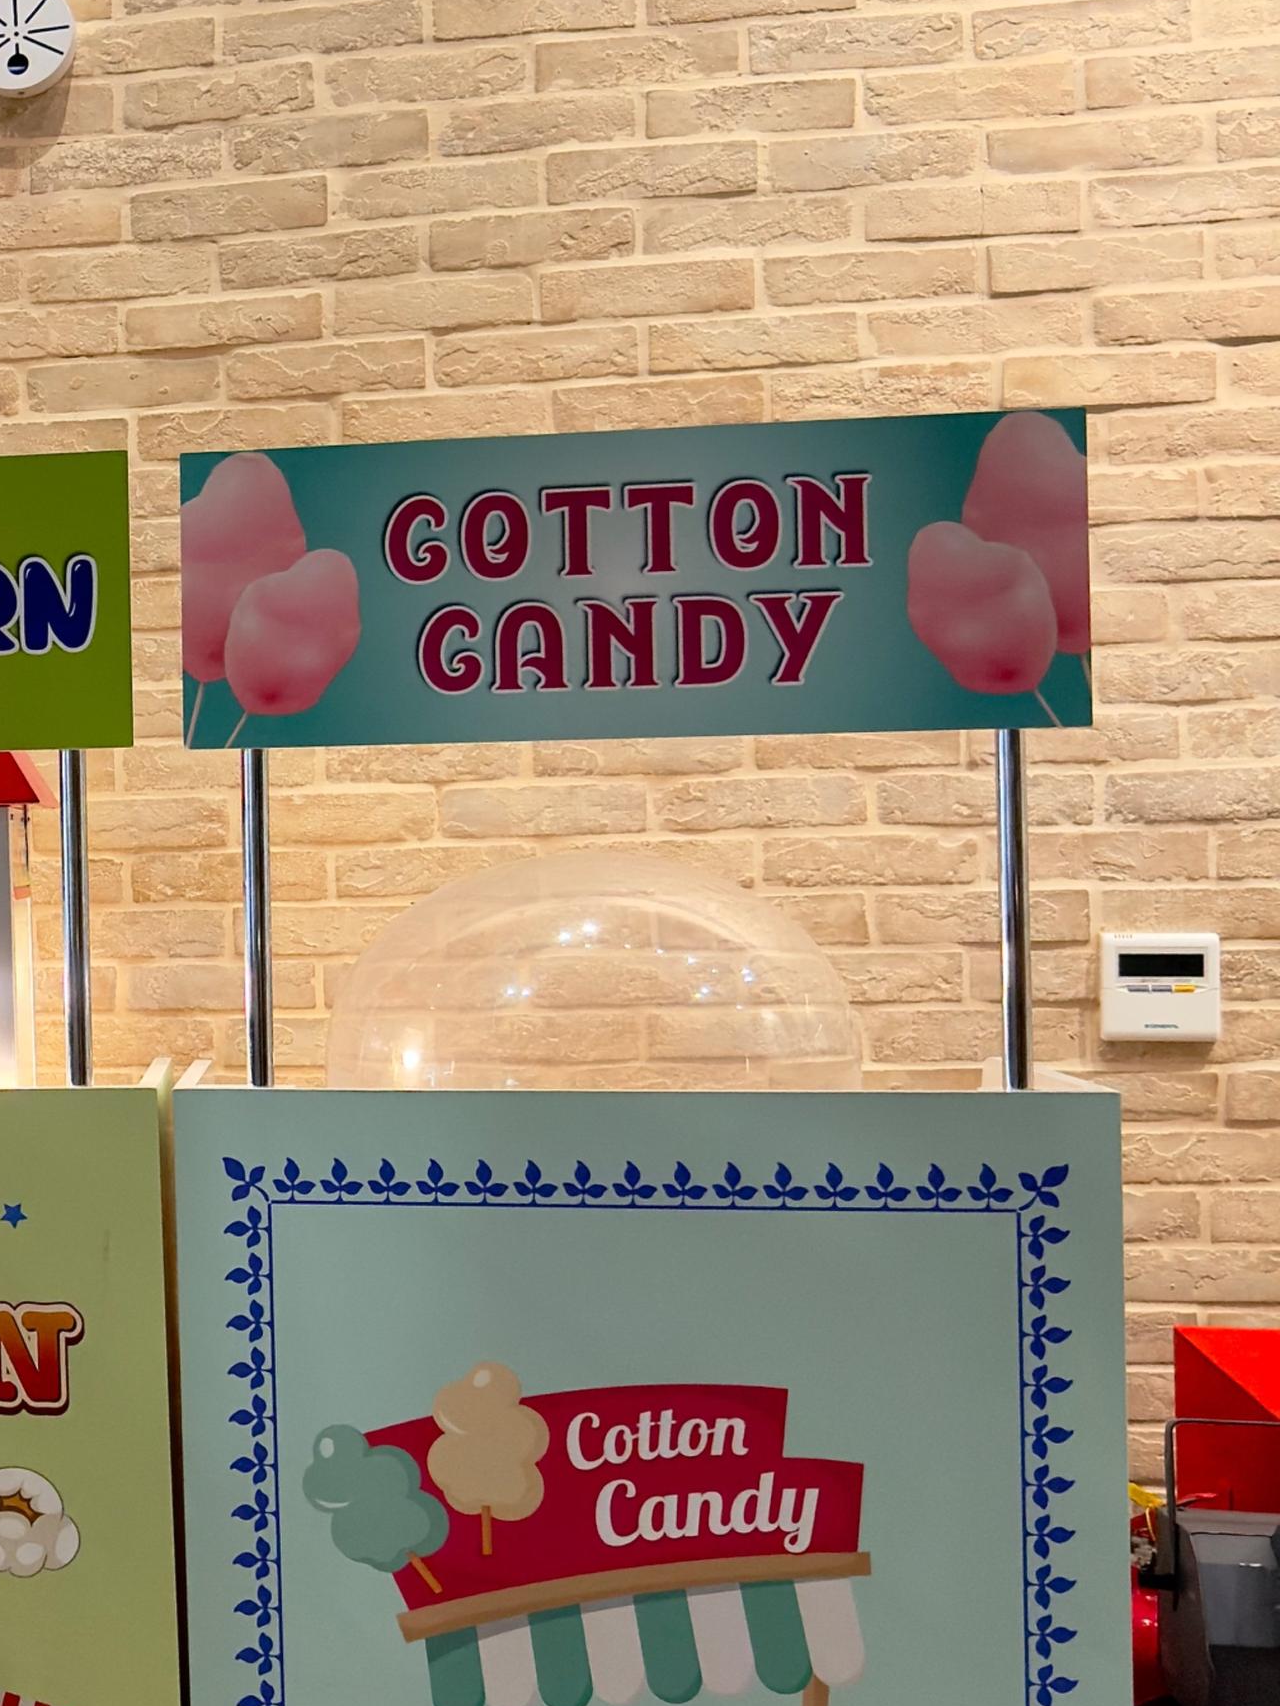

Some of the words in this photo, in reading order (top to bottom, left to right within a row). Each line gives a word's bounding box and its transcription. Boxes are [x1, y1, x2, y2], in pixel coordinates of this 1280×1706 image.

[417, 589, 845, 696] CANDY
[565, 1409, 748, 1473] Cotton
[593, 1471, 821, 1555] Candy
